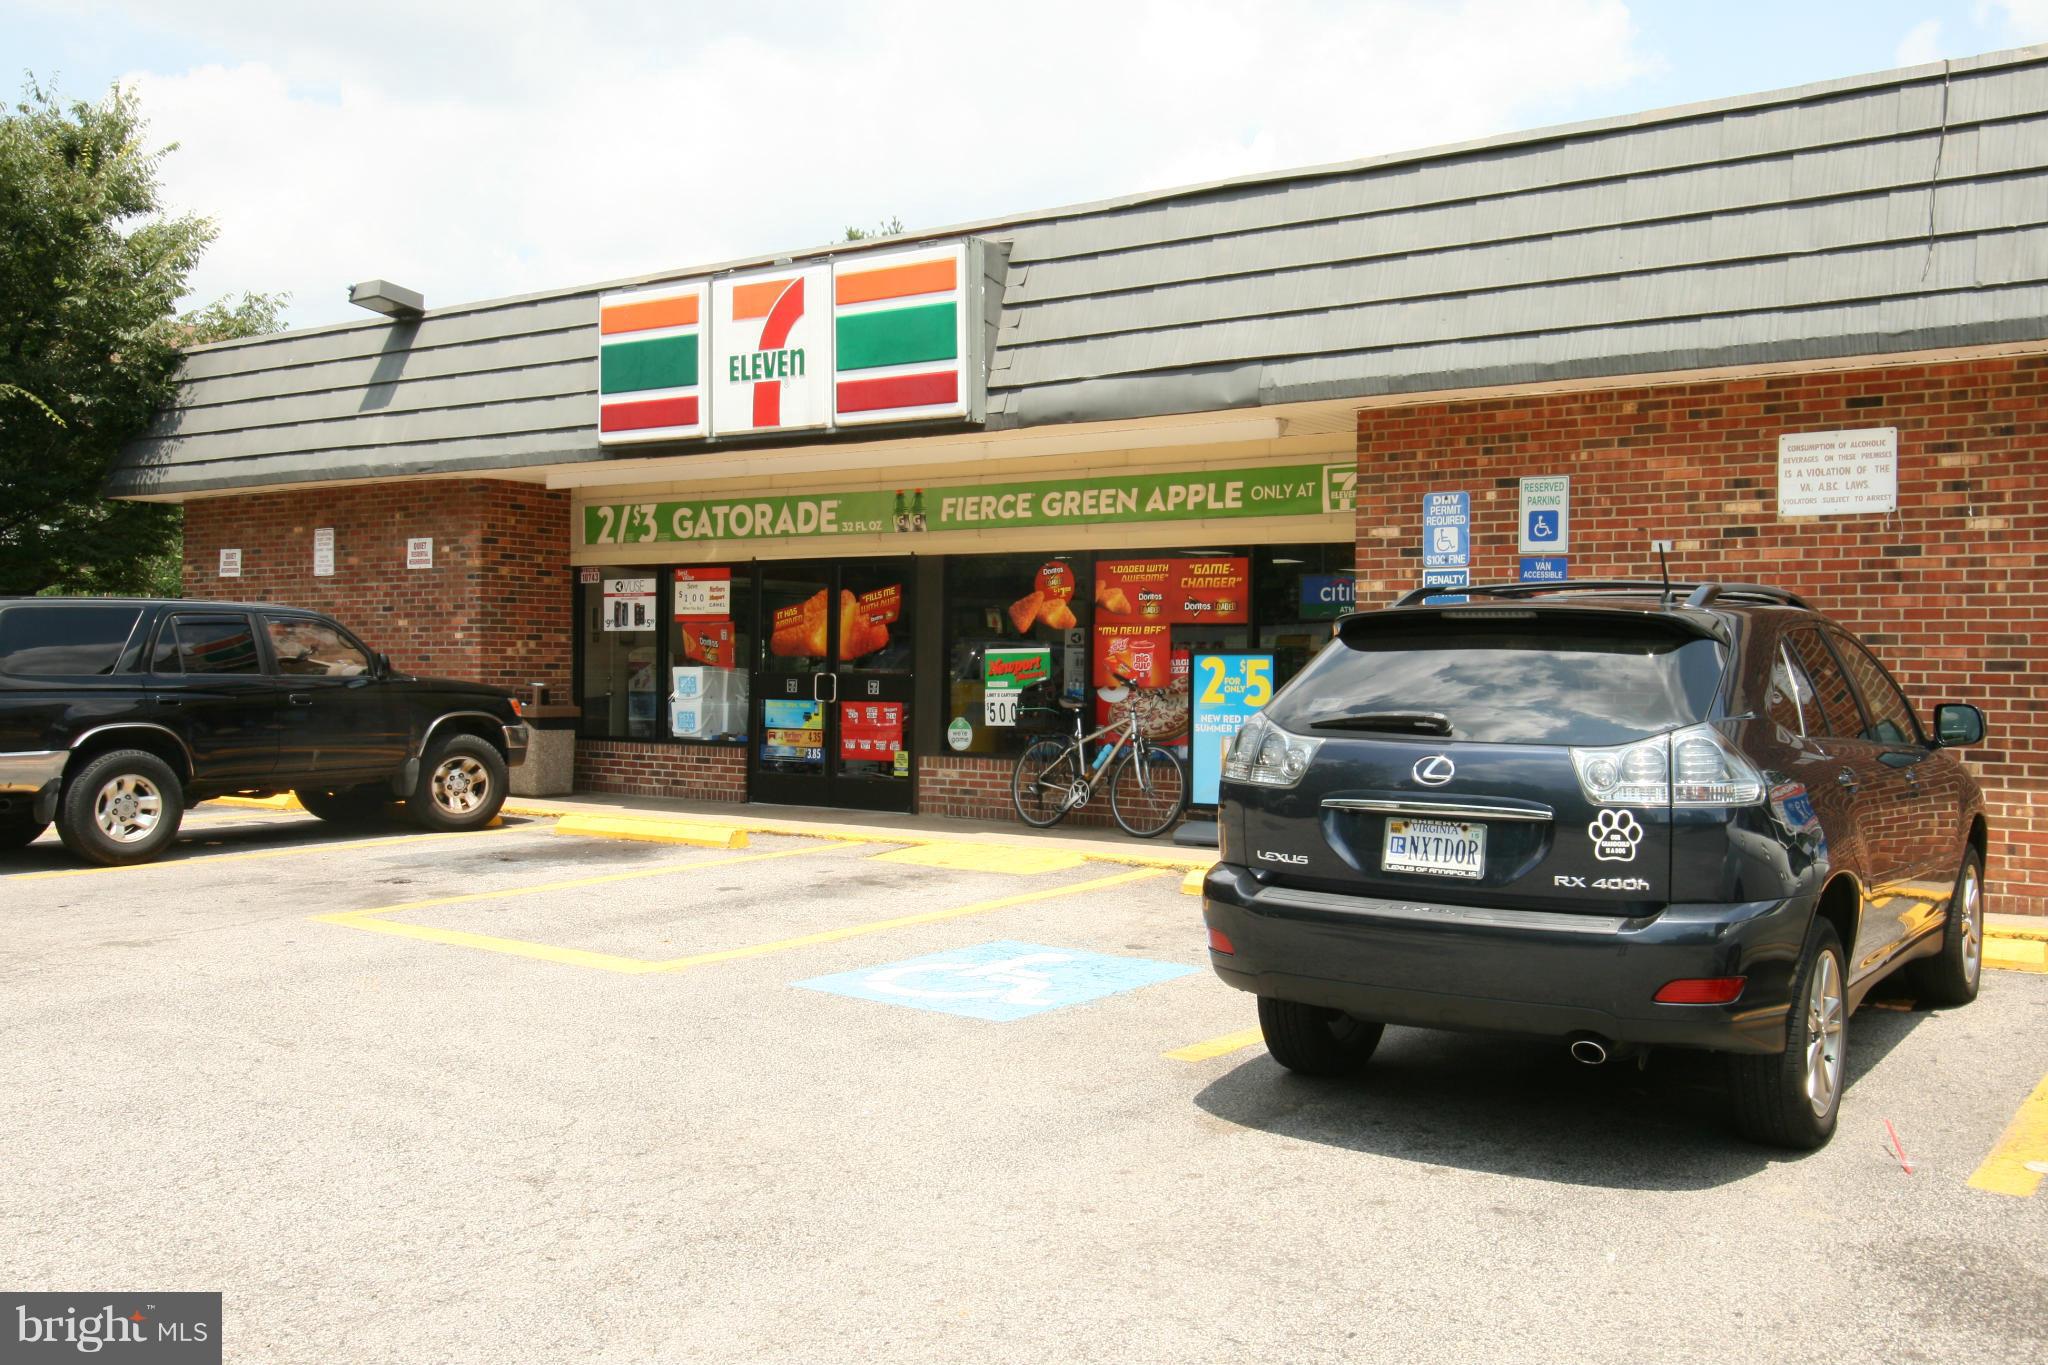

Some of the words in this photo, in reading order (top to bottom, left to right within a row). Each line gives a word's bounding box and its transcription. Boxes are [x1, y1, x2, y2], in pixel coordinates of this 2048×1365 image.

[733, 277, 805, 427] 7
[1787, 443, 1836, 453] CONSUMPTION
[1838, 441, 1847, 449] OF
[1850, 439, 1887, 448] ALCOHOLIC
[1782, 456, 1818, 464] BEVERAGES
[1838, 453, 1856, 461] THESE
[1861, 451, 1893, 460] PREMISES
[1784, 469, 1792, 478] IS
[1806, 466, 1851, 477] VIOLATION
[1856, 465, 1867, 474] OF
[1874, 464, 1891, 473] THE
[1524, 481, 1565, 492] RESERVED
[1331, 489, 1357, 500] ELEVE
[1433, 494, 1459, 504] DMV
[940, 492, 1033, 522] FIERCE
[1041, 487, 1139, 517] GREEN
[1145, 481, 1244, 512] APPLE
[1251, 483, 1294, 501] ONLY
[1296, 482, 1316, 498] AT
[1527, 495, 1561, 505] PARKING
[1782, 497, 1818, 505] VIOLATORS
[1822, 495, 1850, 503] SUBJECT
[1430, 504, 1462, 515] PERMIT
[672, 500, 839, 539] GATORADE
[842, 522, 854, 532] 32
[856, 521, 868, 532] FL
[869, 520, 883, 531] OZ
[1426, 515, 1466, 526] REQUIRED
[1448, 554, 1466, 564] FINE
[1042, 567, 1064, 576] Doritos
[1146, 564, 1169, 573] WITH
[1535, 562, 1552, 571] VAN
[1427, 574, 1465, 584] PENALTY
[1523, 570, 1563, 579] ACCESSIBLE
[623, 580, 645, 592] VUSE
[883, 586, 896, 596] ME
[1138, 592, 1163, 601] Doritos
[1184, 601, 1212, 611] Doritos
[1339, 606, 1354, 614] ATM
[784, 607, 798, 618] HAS
[1120, 626, 1142, 635] NEW
[1135, 654, 1150, 663] BIG
[988, 656, 1041, 677] Newport
[1133, 662, 1151, 670] GULP
[1200, 656, 1226, 703] 2
[1224, 677, 1241, 685] FOR
[1224, 685, 1246, 693] ONLY
[1200, 714, 1221, 723] NEW
[1223, 714, 1241, 723] RED
[1194, 724, 1233, 733] SUMMER
[808, 732, 821, 742] 4.35
[951, 736, 970, 744] game
[1411, 823, 1459, 835] VIRGINIA
[1408, 836, 1479, 866] NXTDOR
[1256, 850, 1309, 865] LEXUS
[1386, 864, 1415, 872] LEXUS
[1428, 868, 1477, 877] ANNAPOLIS
[1553, 875, 1586, 888] RX
[1591, 878, 1650, 890] 400h
